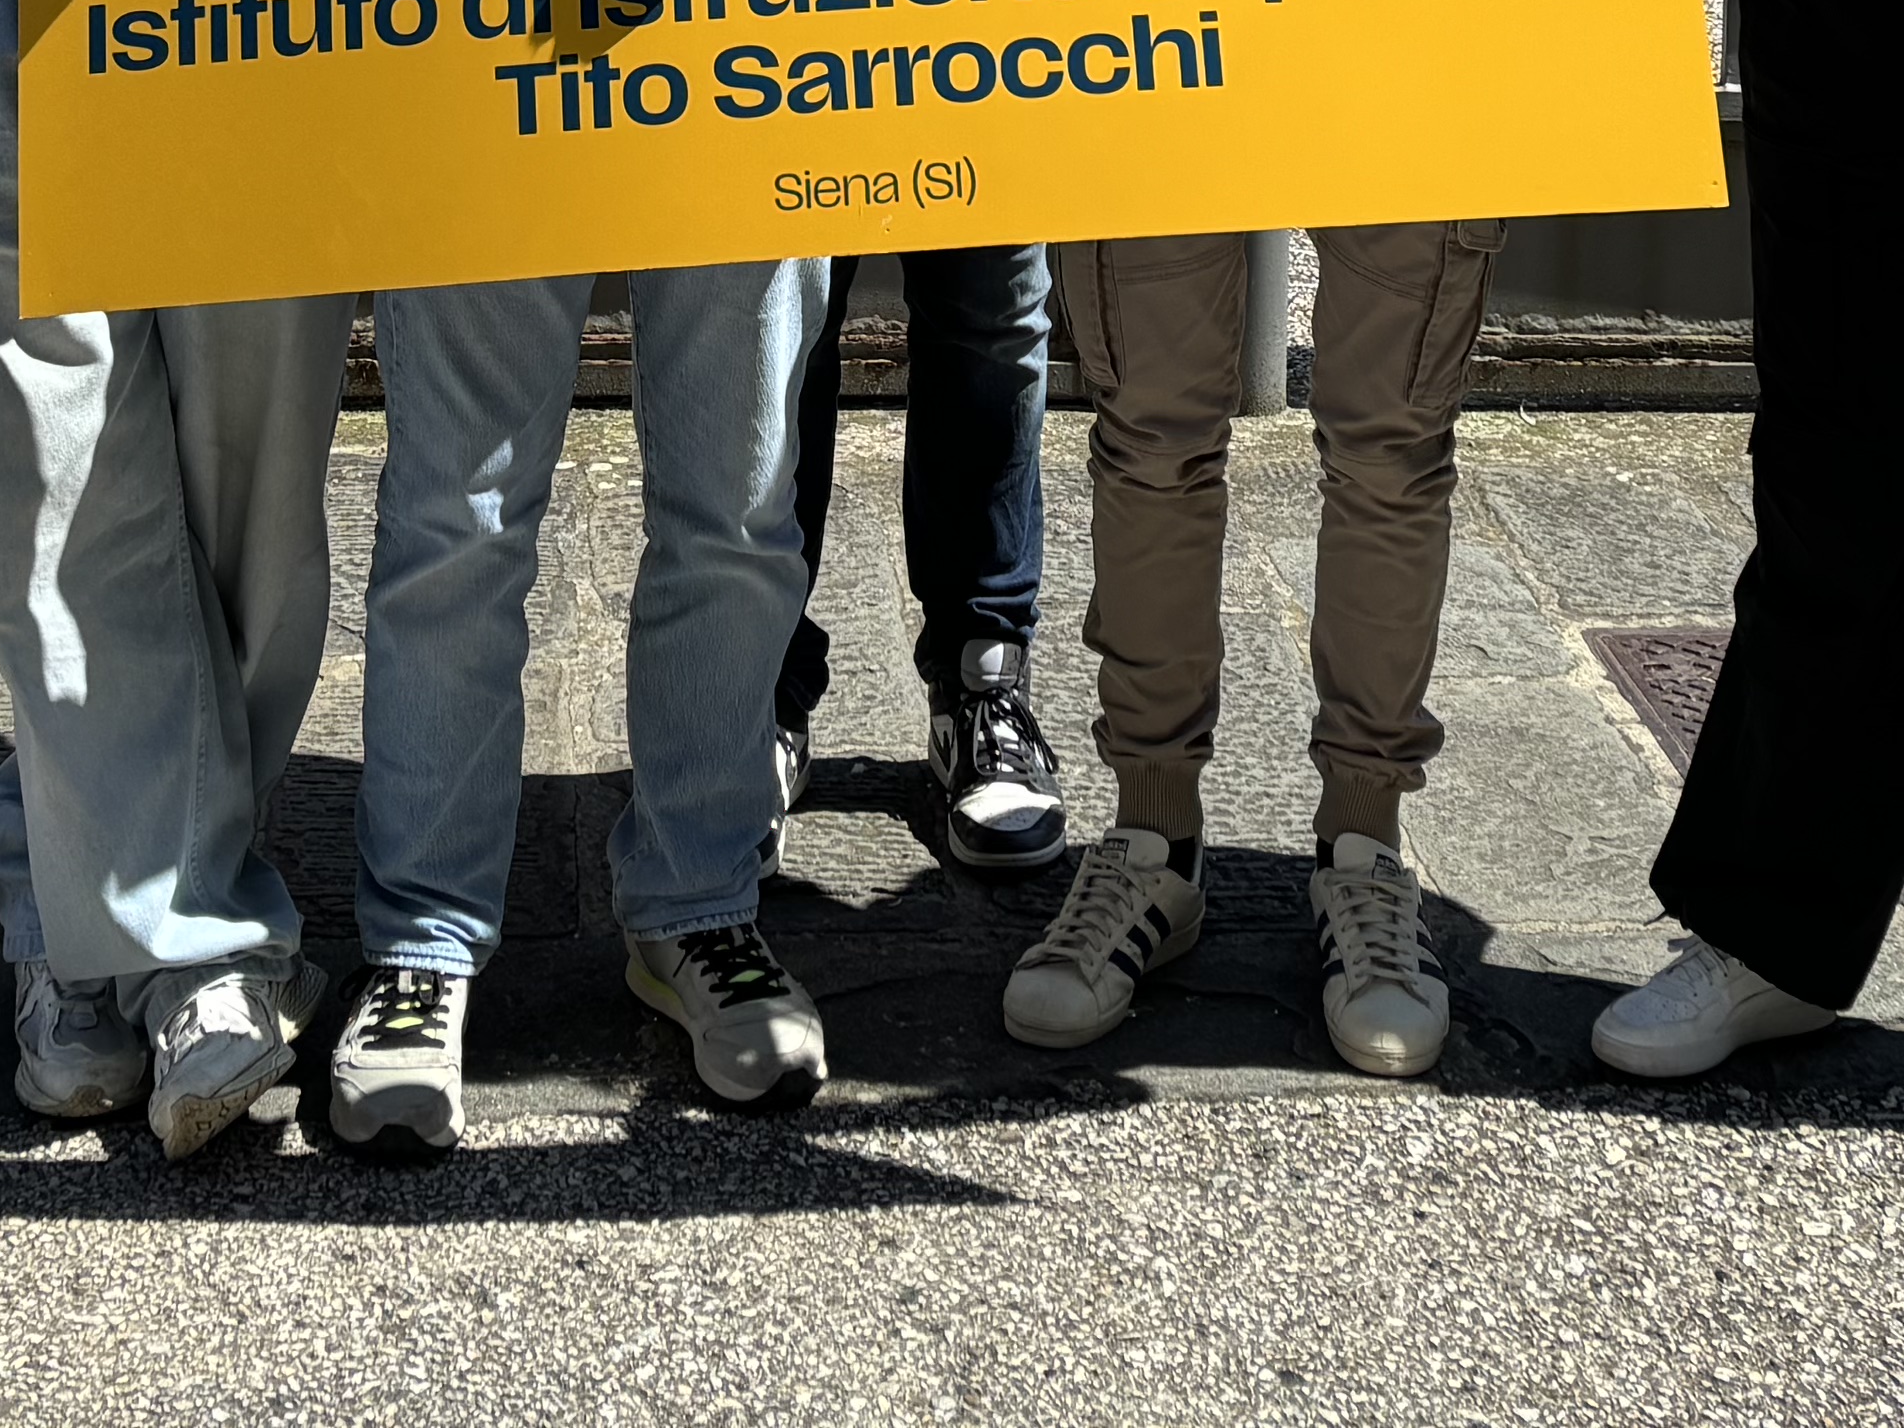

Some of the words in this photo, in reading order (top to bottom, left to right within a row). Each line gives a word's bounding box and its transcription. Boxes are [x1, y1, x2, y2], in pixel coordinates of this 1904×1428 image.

[494, 52, 690, 137] Tito
[713, 9, 1225, 120] Sarrocchi
[774, 171, 900, 211] Siena
[912, 156, 977, 210] (SI)
